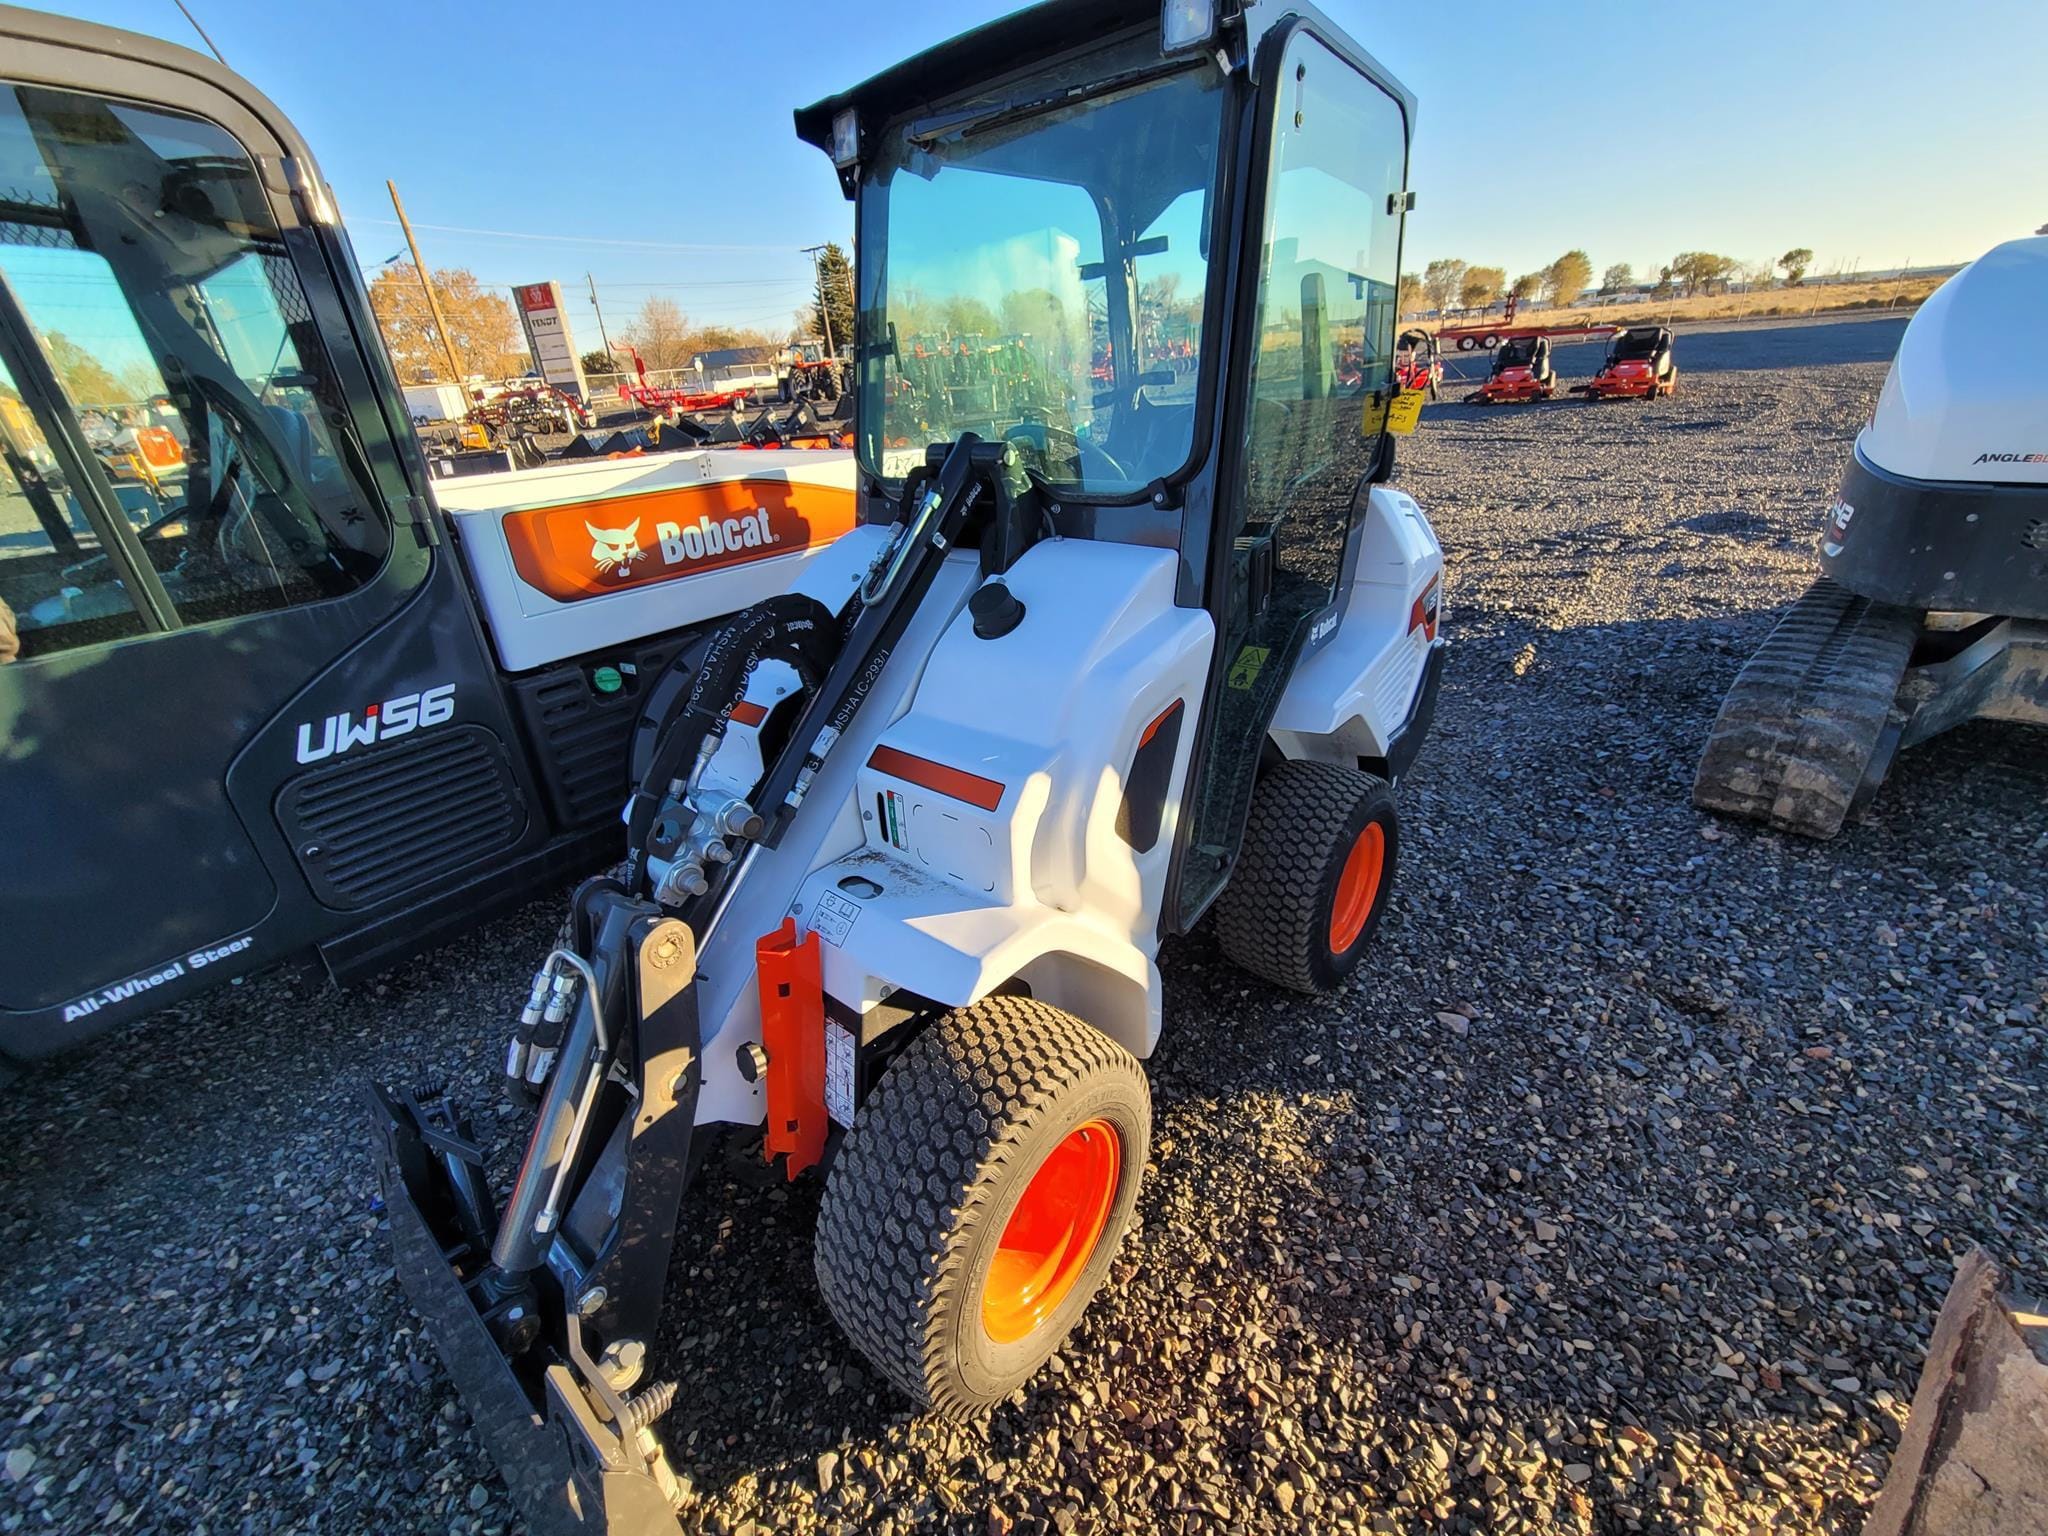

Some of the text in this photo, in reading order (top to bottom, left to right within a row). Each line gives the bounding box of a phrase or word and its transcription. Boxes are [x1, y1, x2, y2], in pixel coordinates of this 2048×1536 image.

[655, 507, 772, 566] Bobcat
[1830, 496, 1855, 530] 42
[785, 618, 815, 633] Bobcat
[832, 648, 891, 733] MSHA IC-293/1
[62, 935, 254, 1023] All-Wheel Steer
